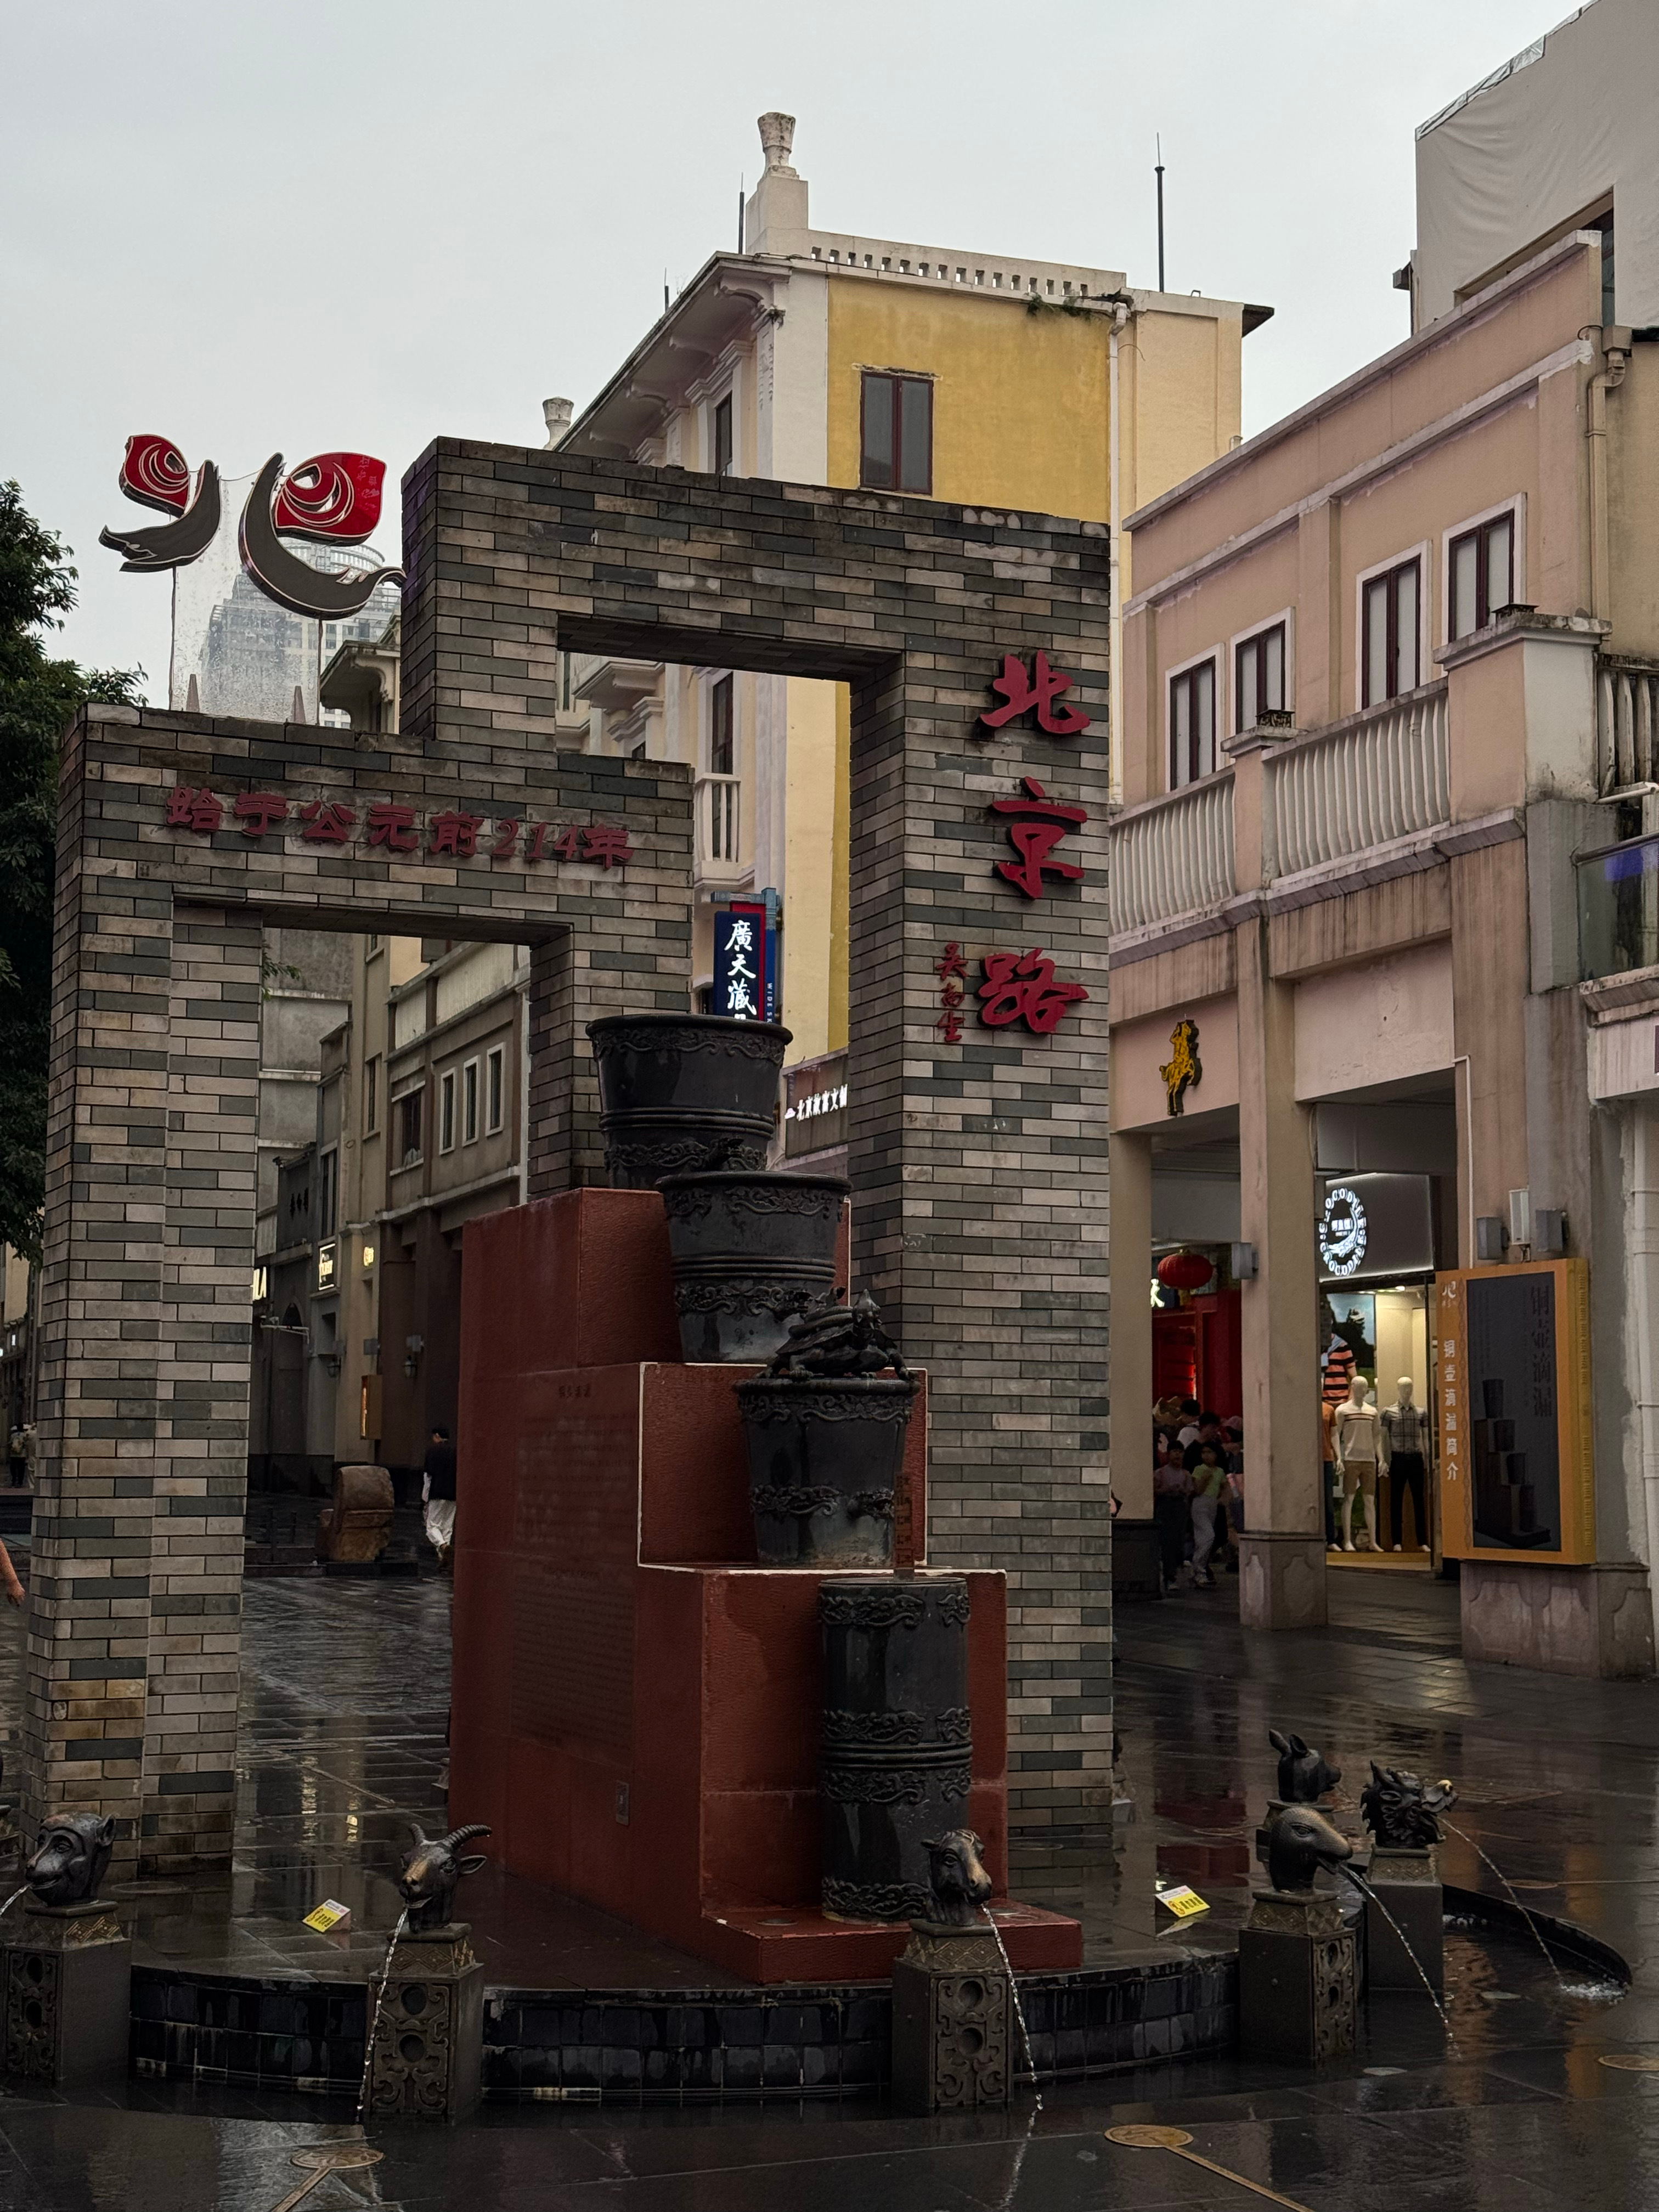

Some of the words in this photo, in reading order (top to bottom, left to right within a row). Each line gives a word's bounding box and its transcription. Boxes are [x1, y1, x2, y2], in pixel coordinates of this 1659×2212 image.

[166, 786, 636, 871] 始于公元前214年
[976, 650, 1091, 1034] 北京路
